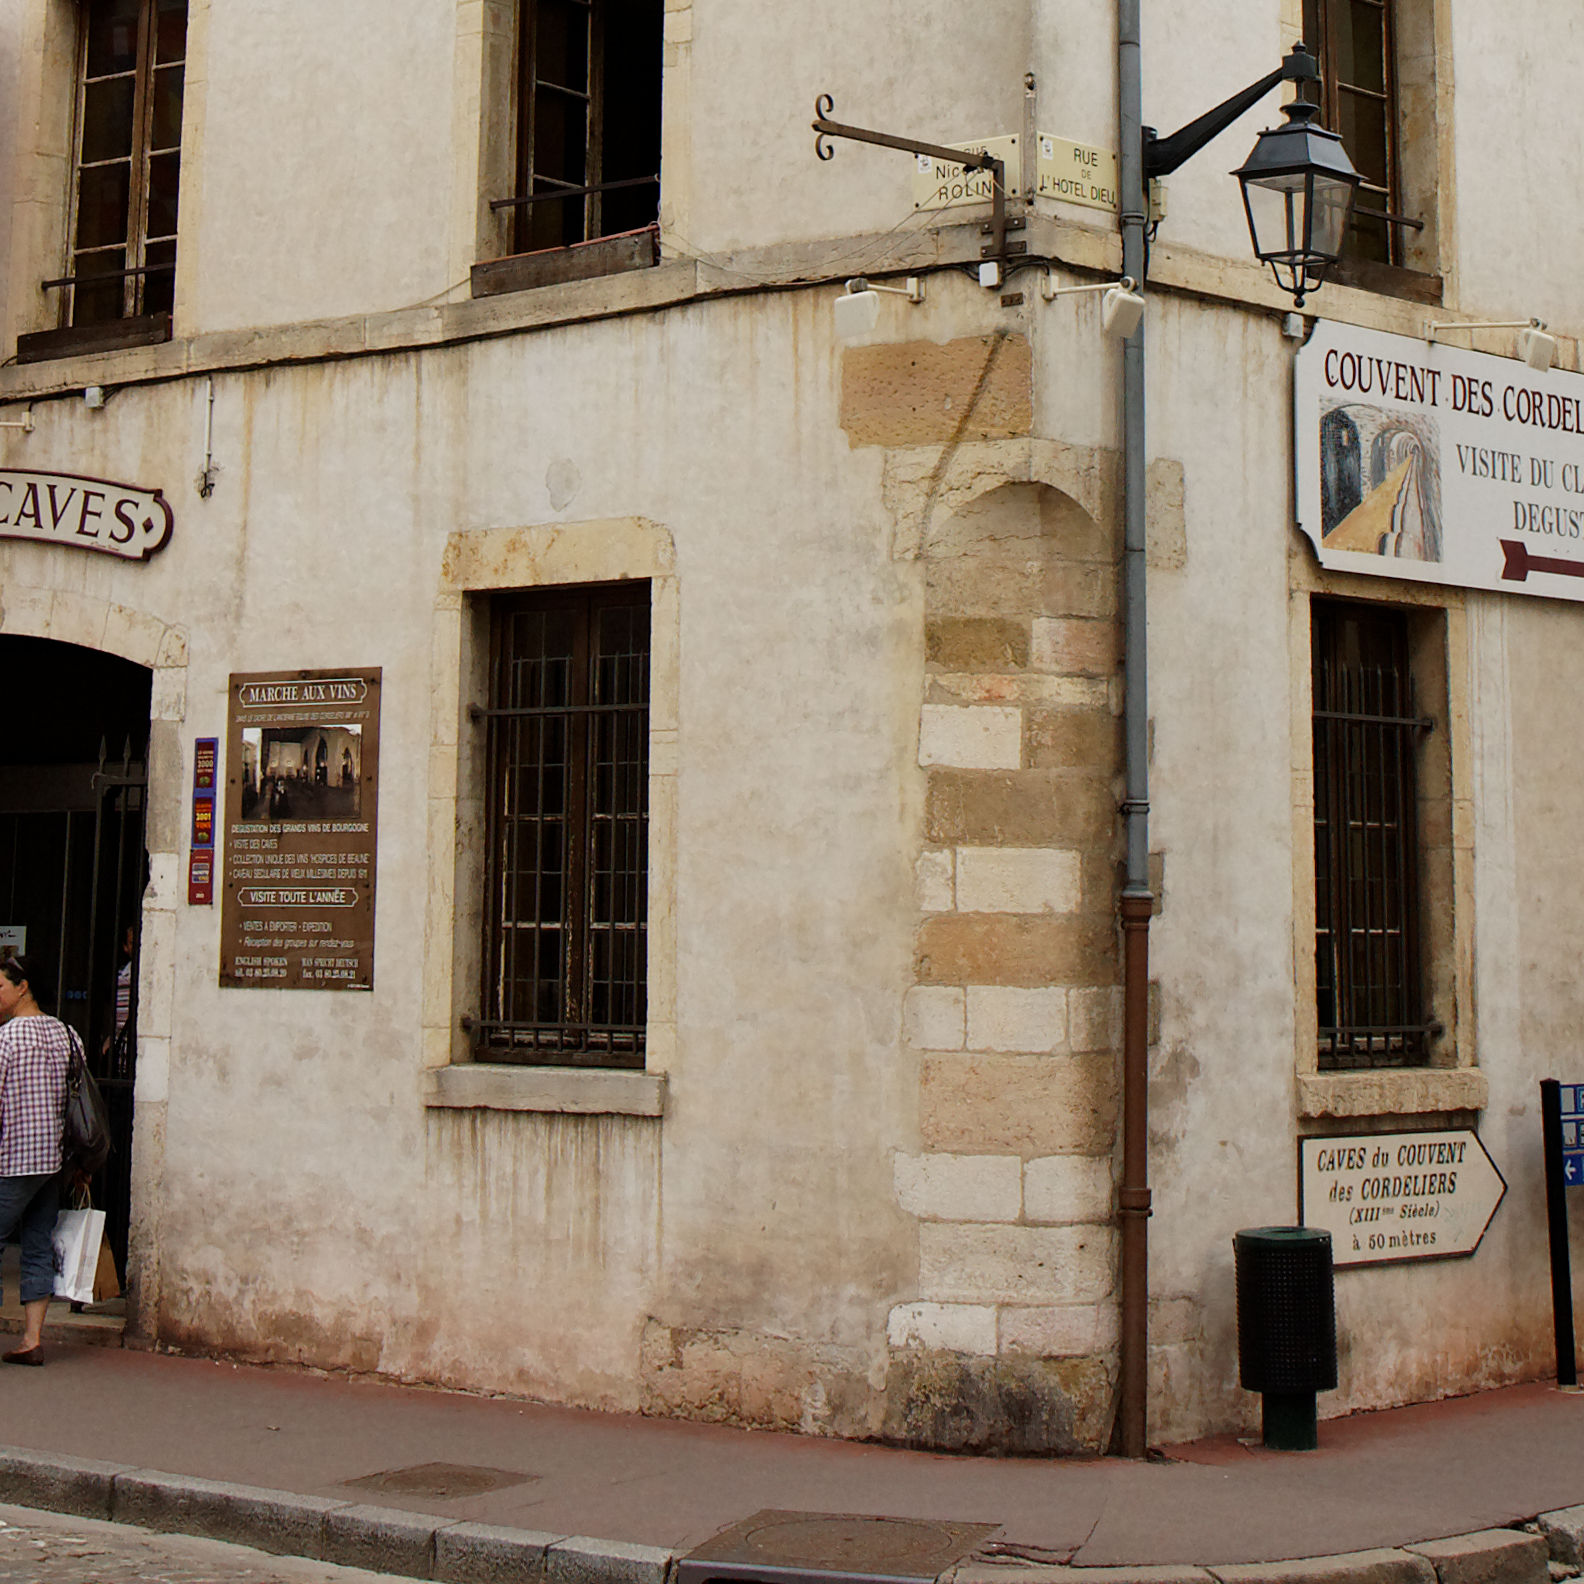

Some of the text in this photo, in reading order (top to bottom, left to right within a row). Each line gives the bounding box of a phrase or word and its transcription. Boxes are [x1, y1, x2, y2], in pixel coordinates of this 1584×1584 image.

[1074, 148, 1098, 167] RUE
[1081, 169, 1092, 180] DE
[938, 180, 993, 201] ROLIN
[1090, 186, 1116, 205] DIEU
[1325, 349, 1441, 407] COUVENT
[1451, 374, 1494, 418] DES
[1456, 443, 1522, 484] VISITE
[1530, 457, 1555, 489] DU
[249, 683, 357, 703] MARCHE AUX VINS
[250, 888, 346, 903] VISITE TOUTE L'ANNÉE
[1317, 1141, 1467, 1172] CAVES du COUVENT
[1329, 1171, 1457, 1202] des CORDELIERS
[1352, 1229, 1437, 1251] à 50 mètres
